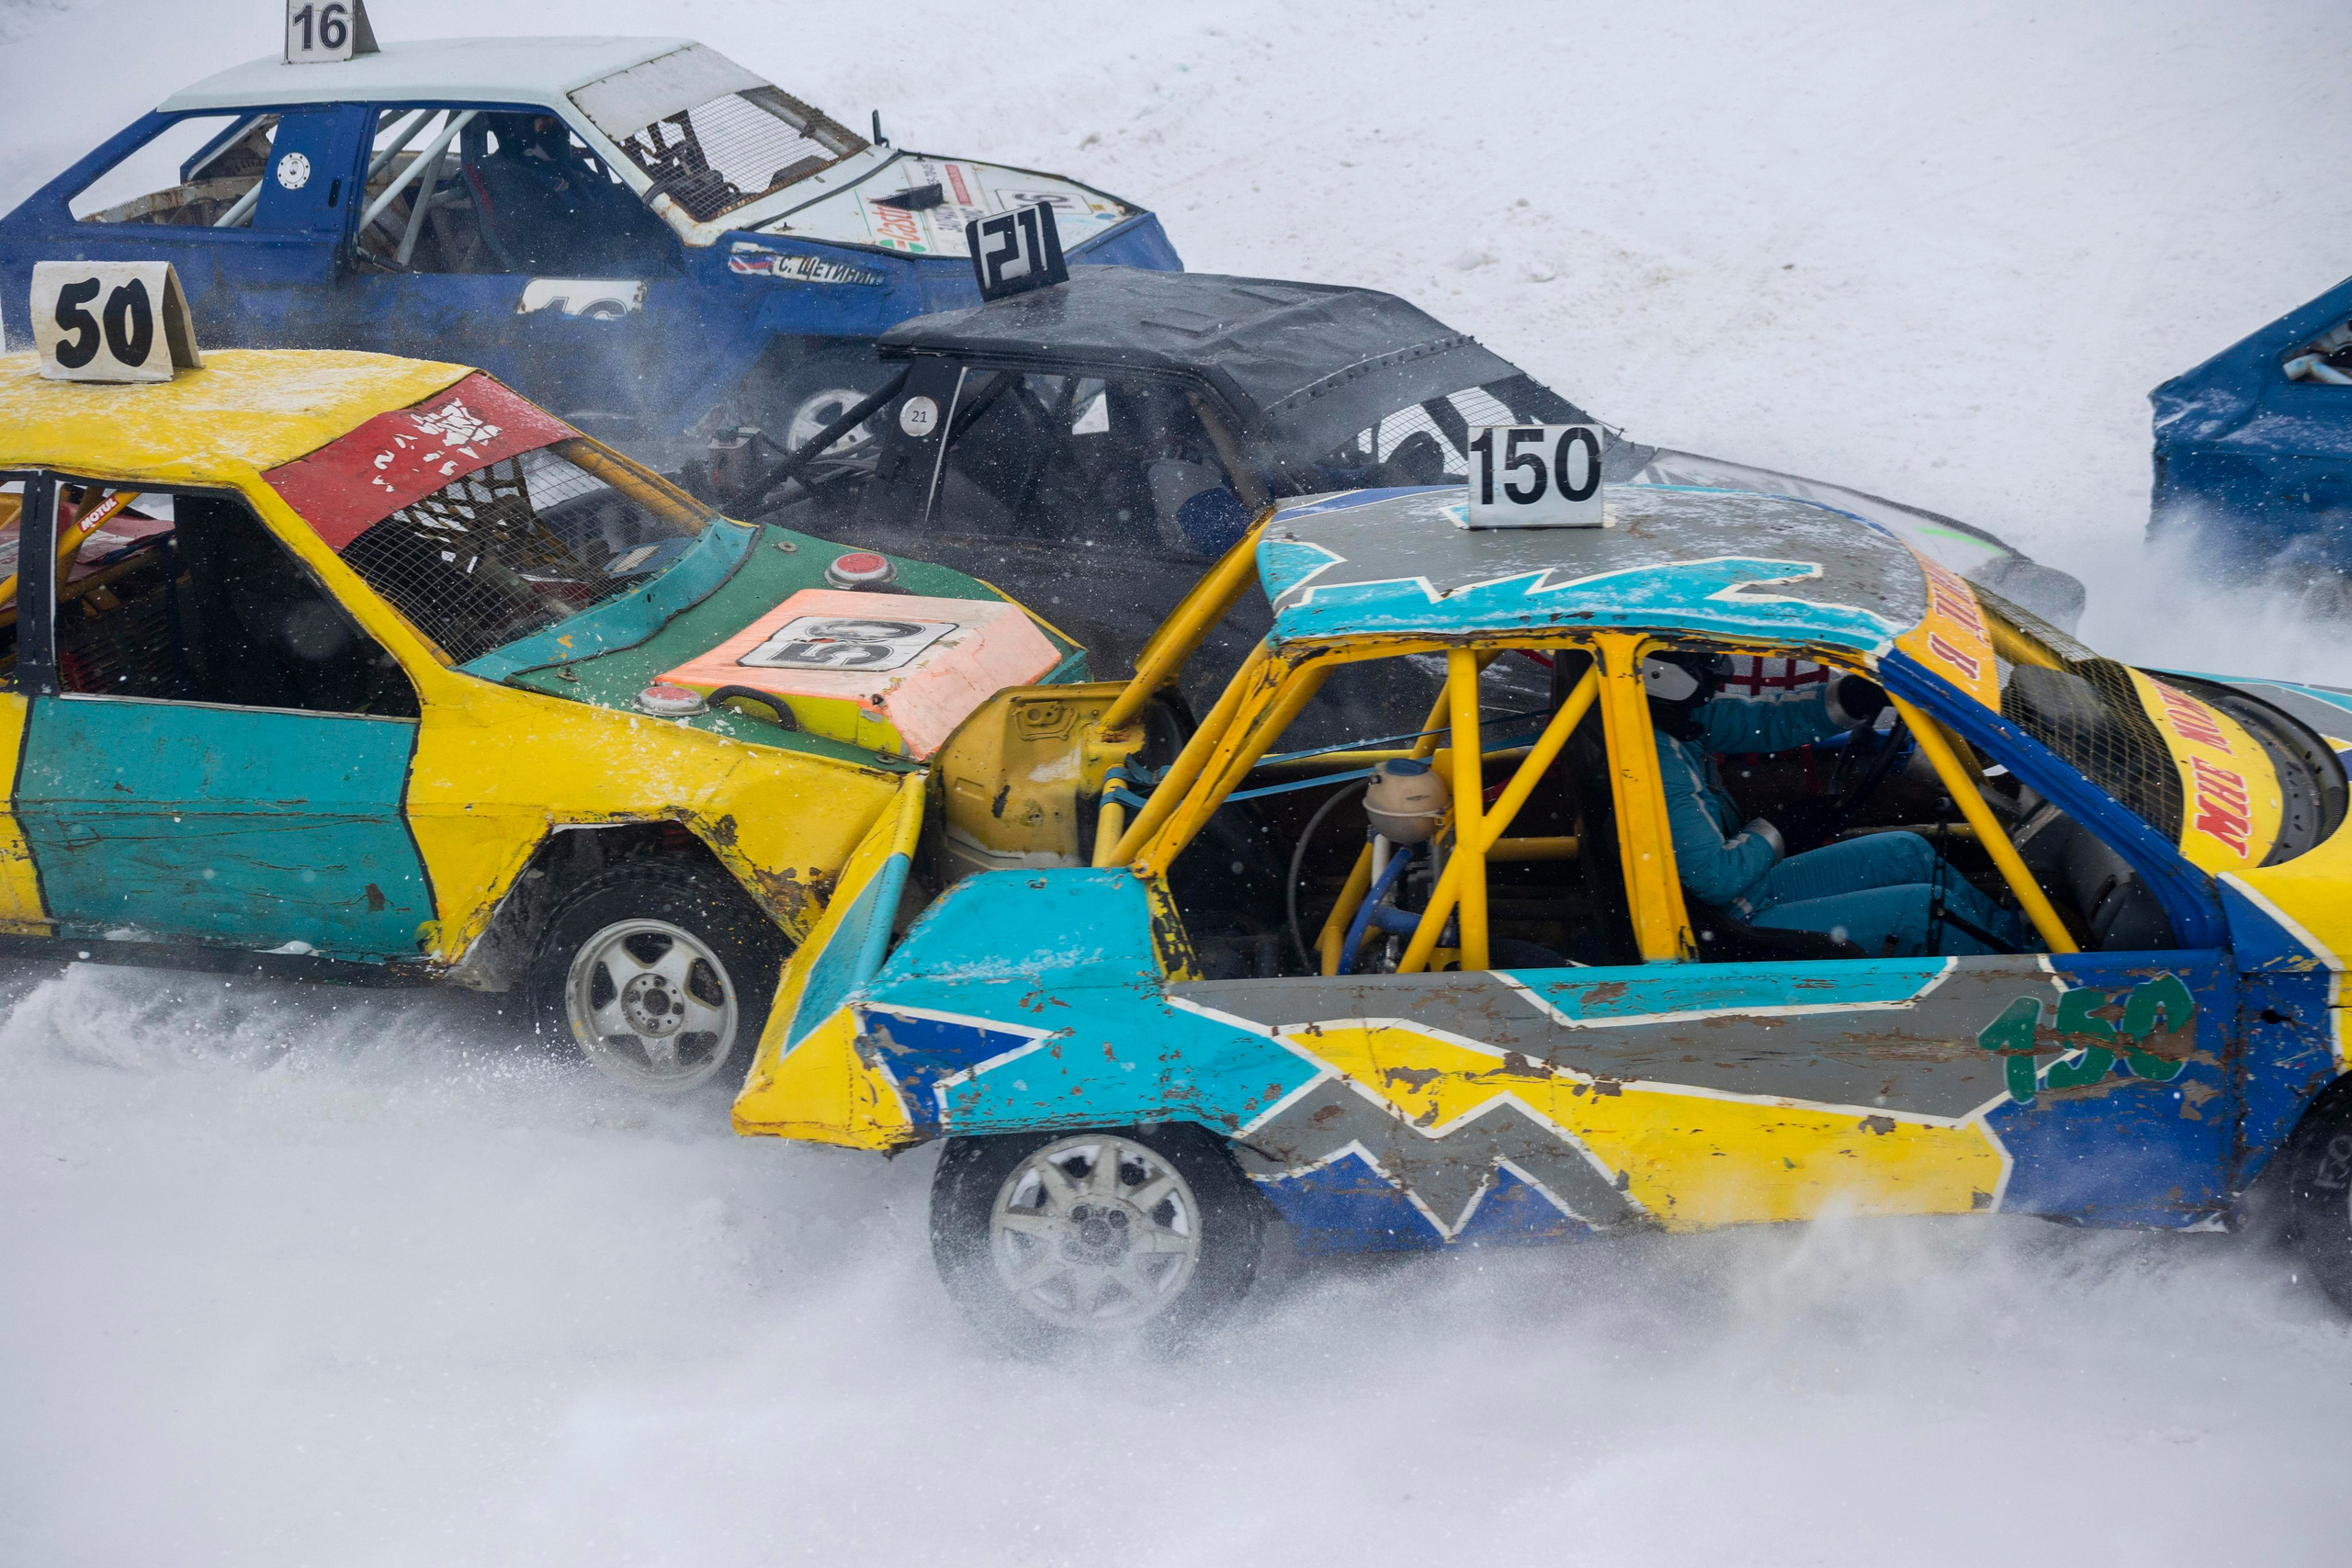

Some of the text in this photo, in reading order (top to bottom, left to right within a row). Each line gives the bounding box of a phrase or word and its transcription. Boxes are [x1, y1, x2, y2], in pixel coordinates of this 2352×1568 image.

[292, 2, 349, 51] 16
[866, 197, 920, 242] Castr
[979, 207, 1045, 292] 21
[54, 276, 154, 367] 50
[911, 410, 927, 423] 21
[1469, 427, 1601, 504] 150
[81, 497, 118, 531] MOTUL
[765, 619, 926, 666] 50
[2188, 753, 2251, 859] МНЕ
[1977, 970, 2196, 1105] 150
